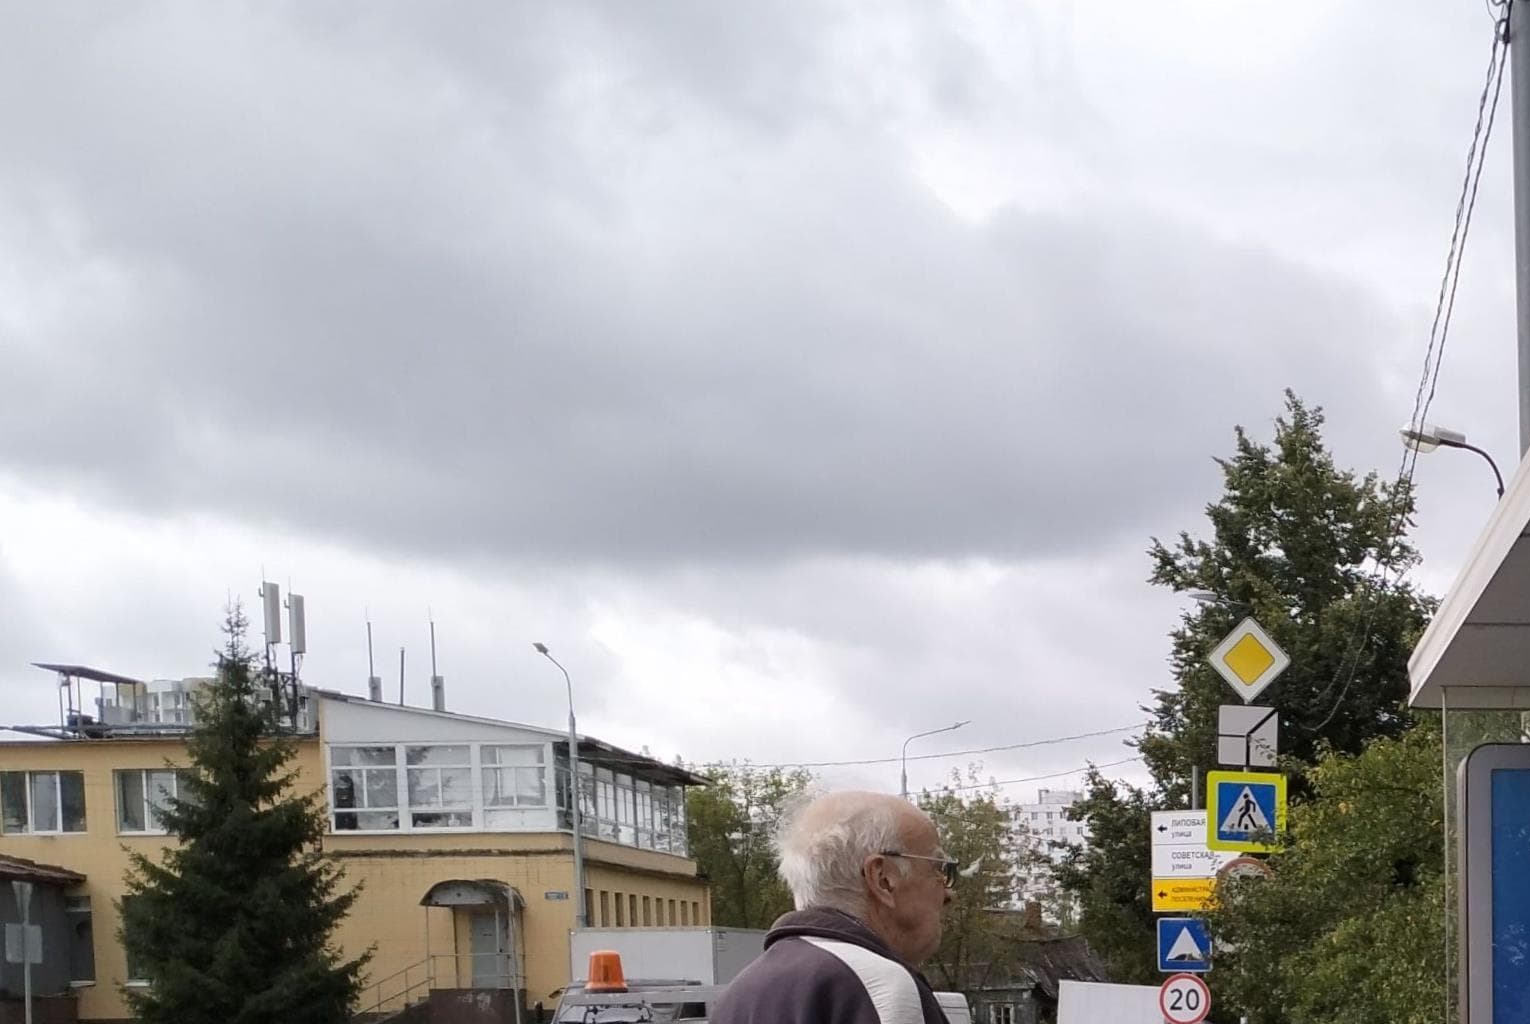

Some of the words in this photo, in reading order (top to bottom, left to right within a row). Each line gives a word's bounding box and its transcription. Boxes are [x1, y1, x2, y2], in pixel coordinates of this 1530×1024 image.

[1171, 831, 1192, 839] улица
[1171, 863, 1193, 871] улица
[1170, 988, 1200, 1011] 20
